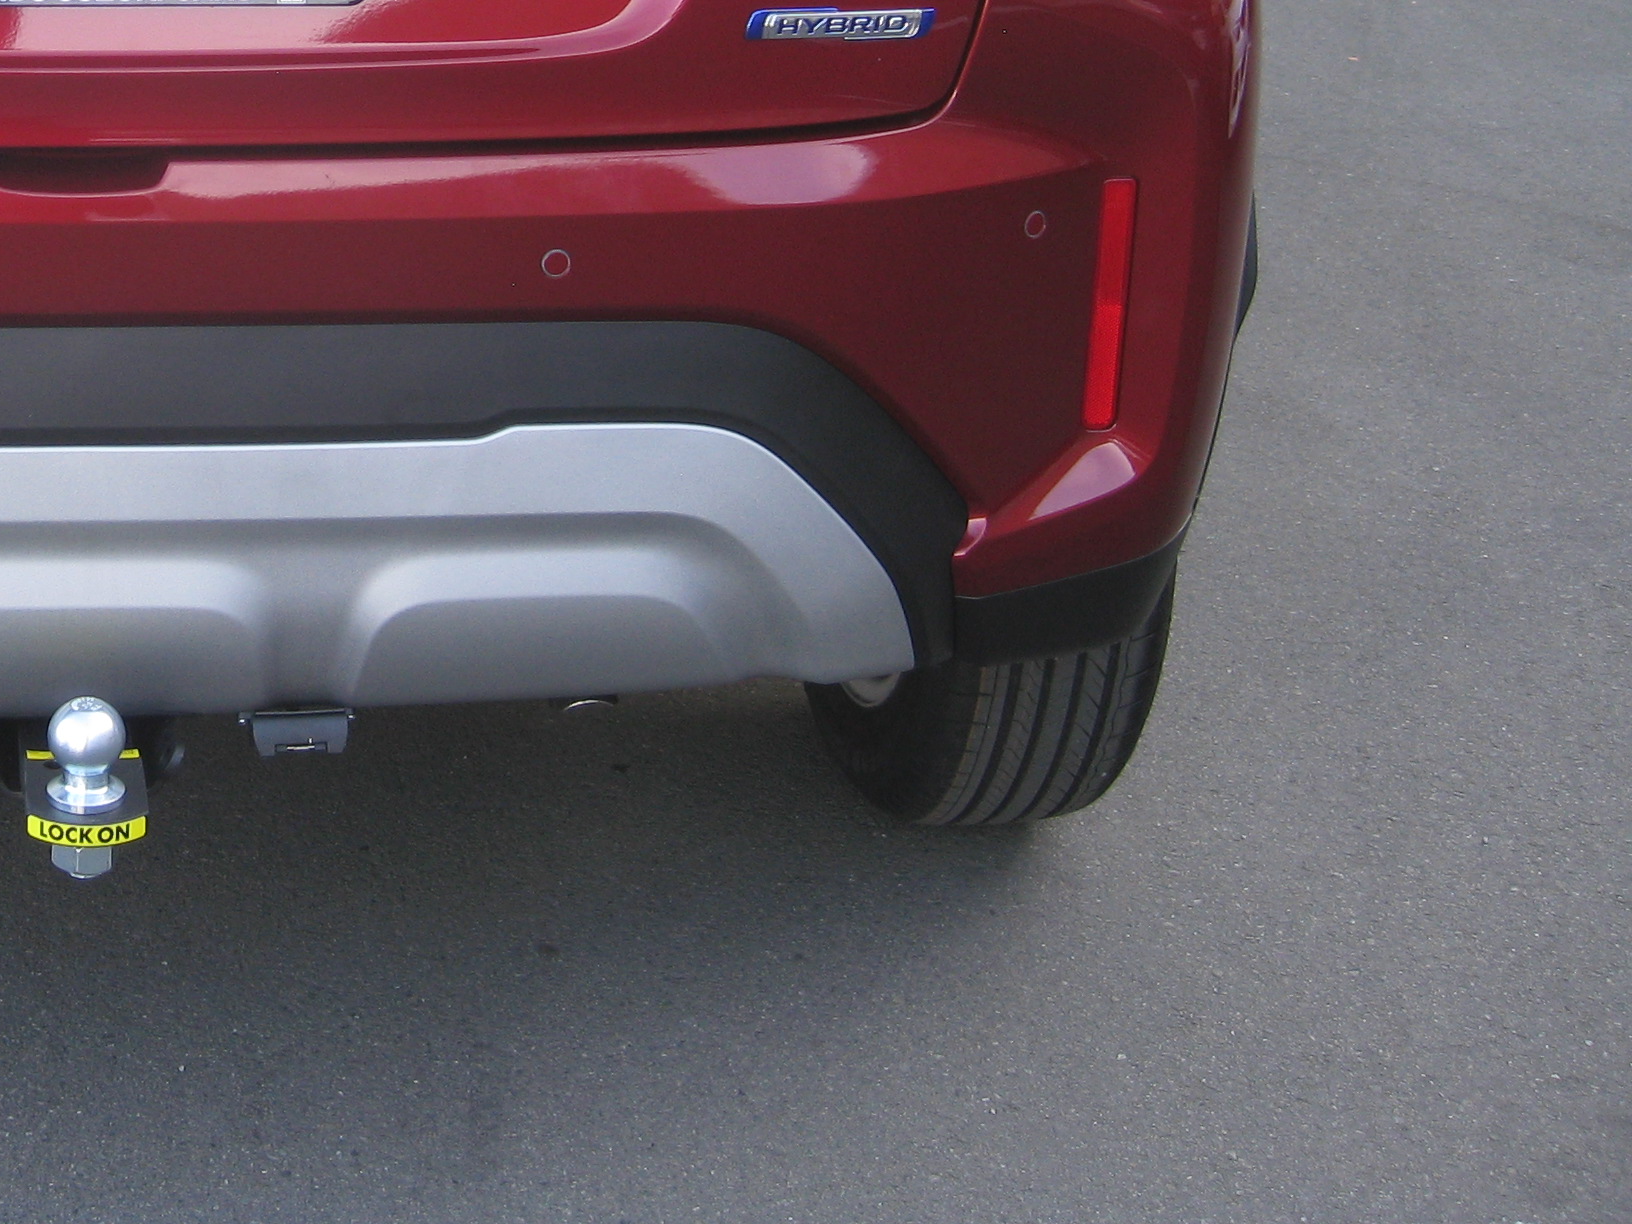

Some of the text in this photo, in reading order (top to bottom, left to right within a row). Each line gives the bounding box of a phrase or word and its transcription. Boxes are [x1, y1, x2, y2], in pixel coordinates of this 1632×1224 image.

[776, 14, 910, 36] HYBRID
[39, 821, 130, 844] LOCK ON
